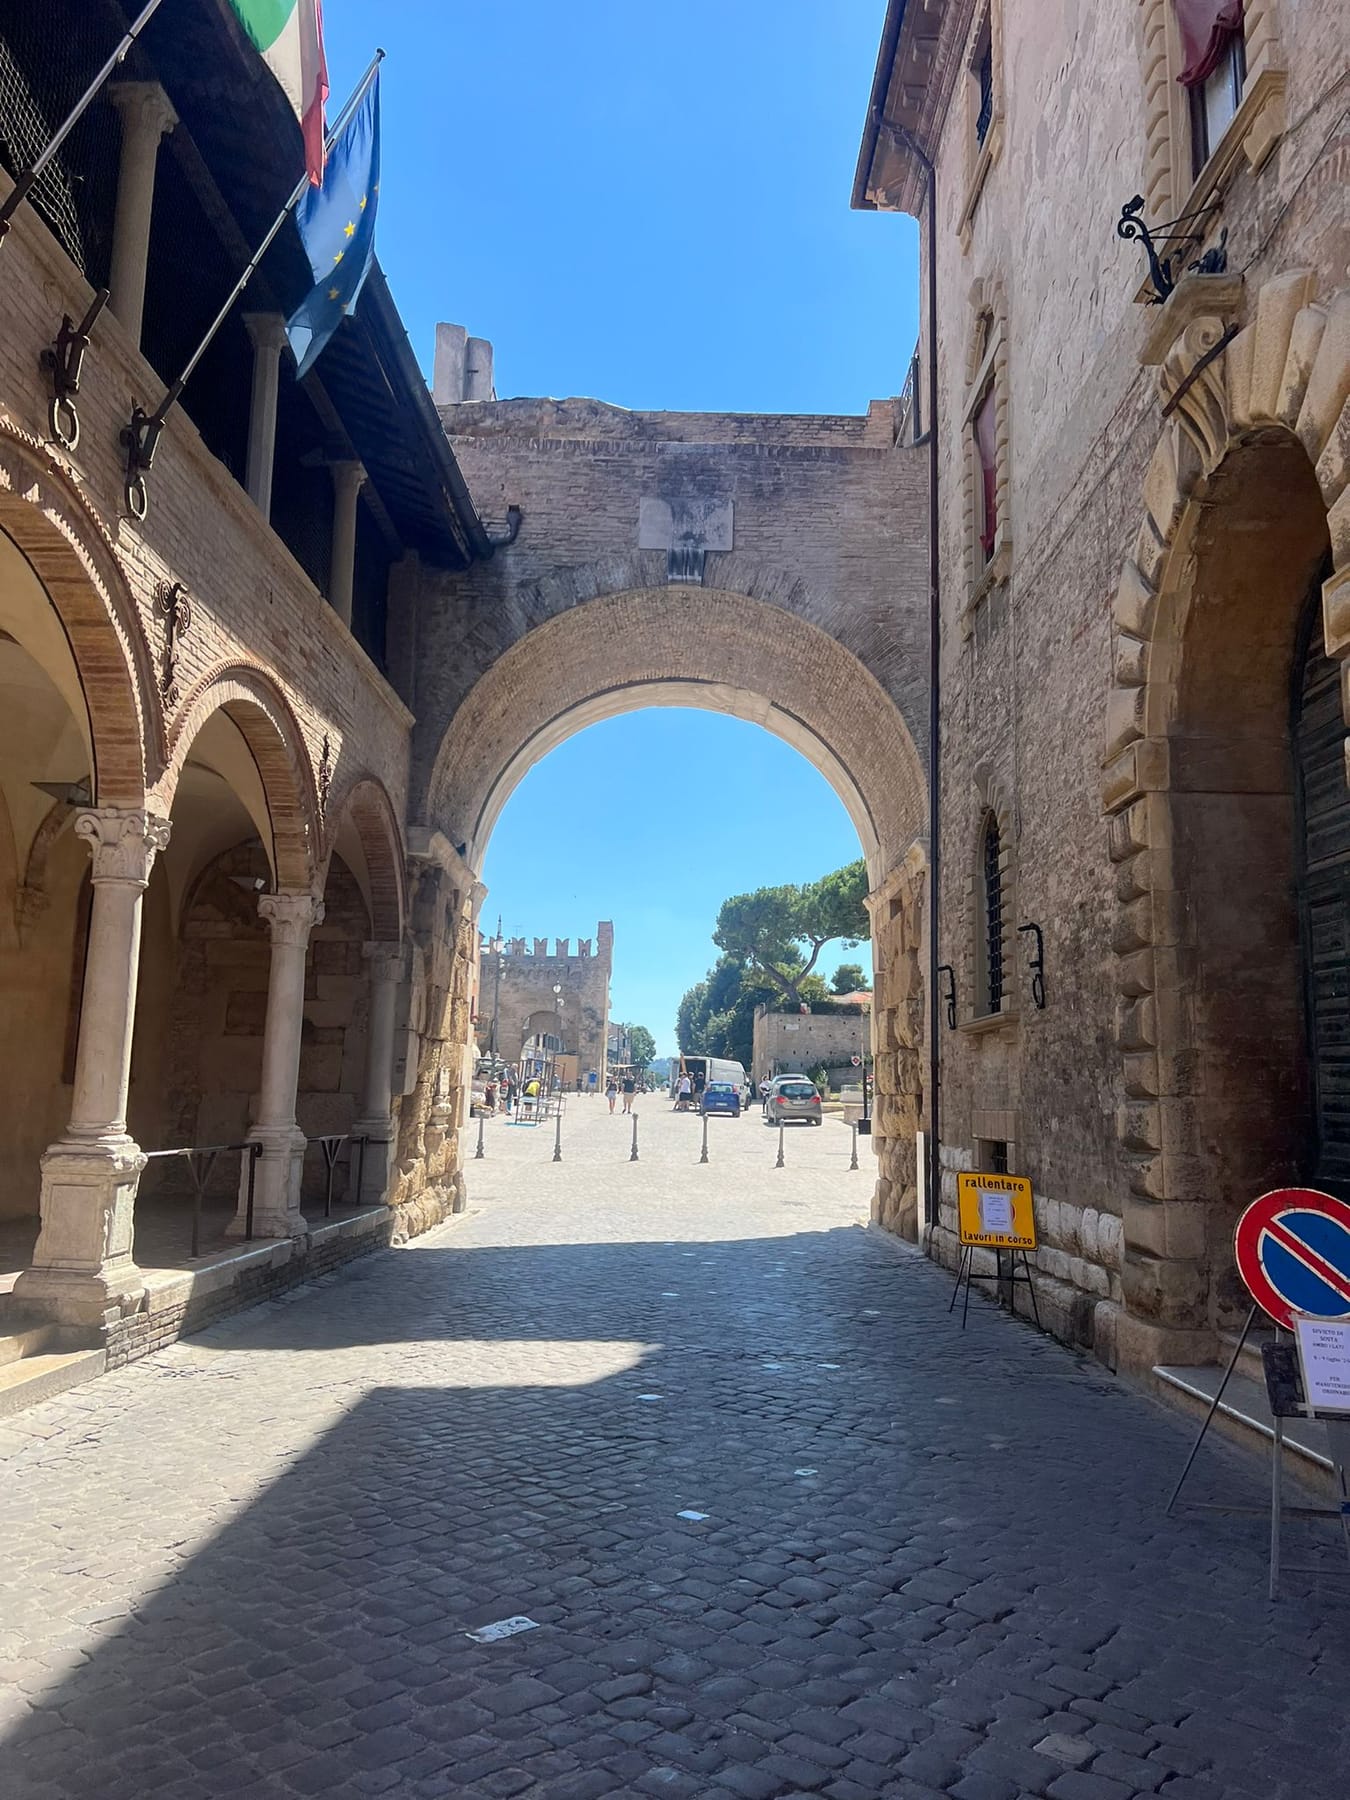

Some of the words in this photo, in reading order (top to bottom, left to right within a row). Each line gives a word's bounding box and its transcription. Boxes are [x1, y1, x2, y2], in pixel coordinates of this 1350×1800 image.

[965, 1177, 1025, 1192] rallentare
[964, 1231, 992, 1242] lavori
[995, 1234, 1004, 1243] in
[1007, 1236, 1033, 1245] corso
